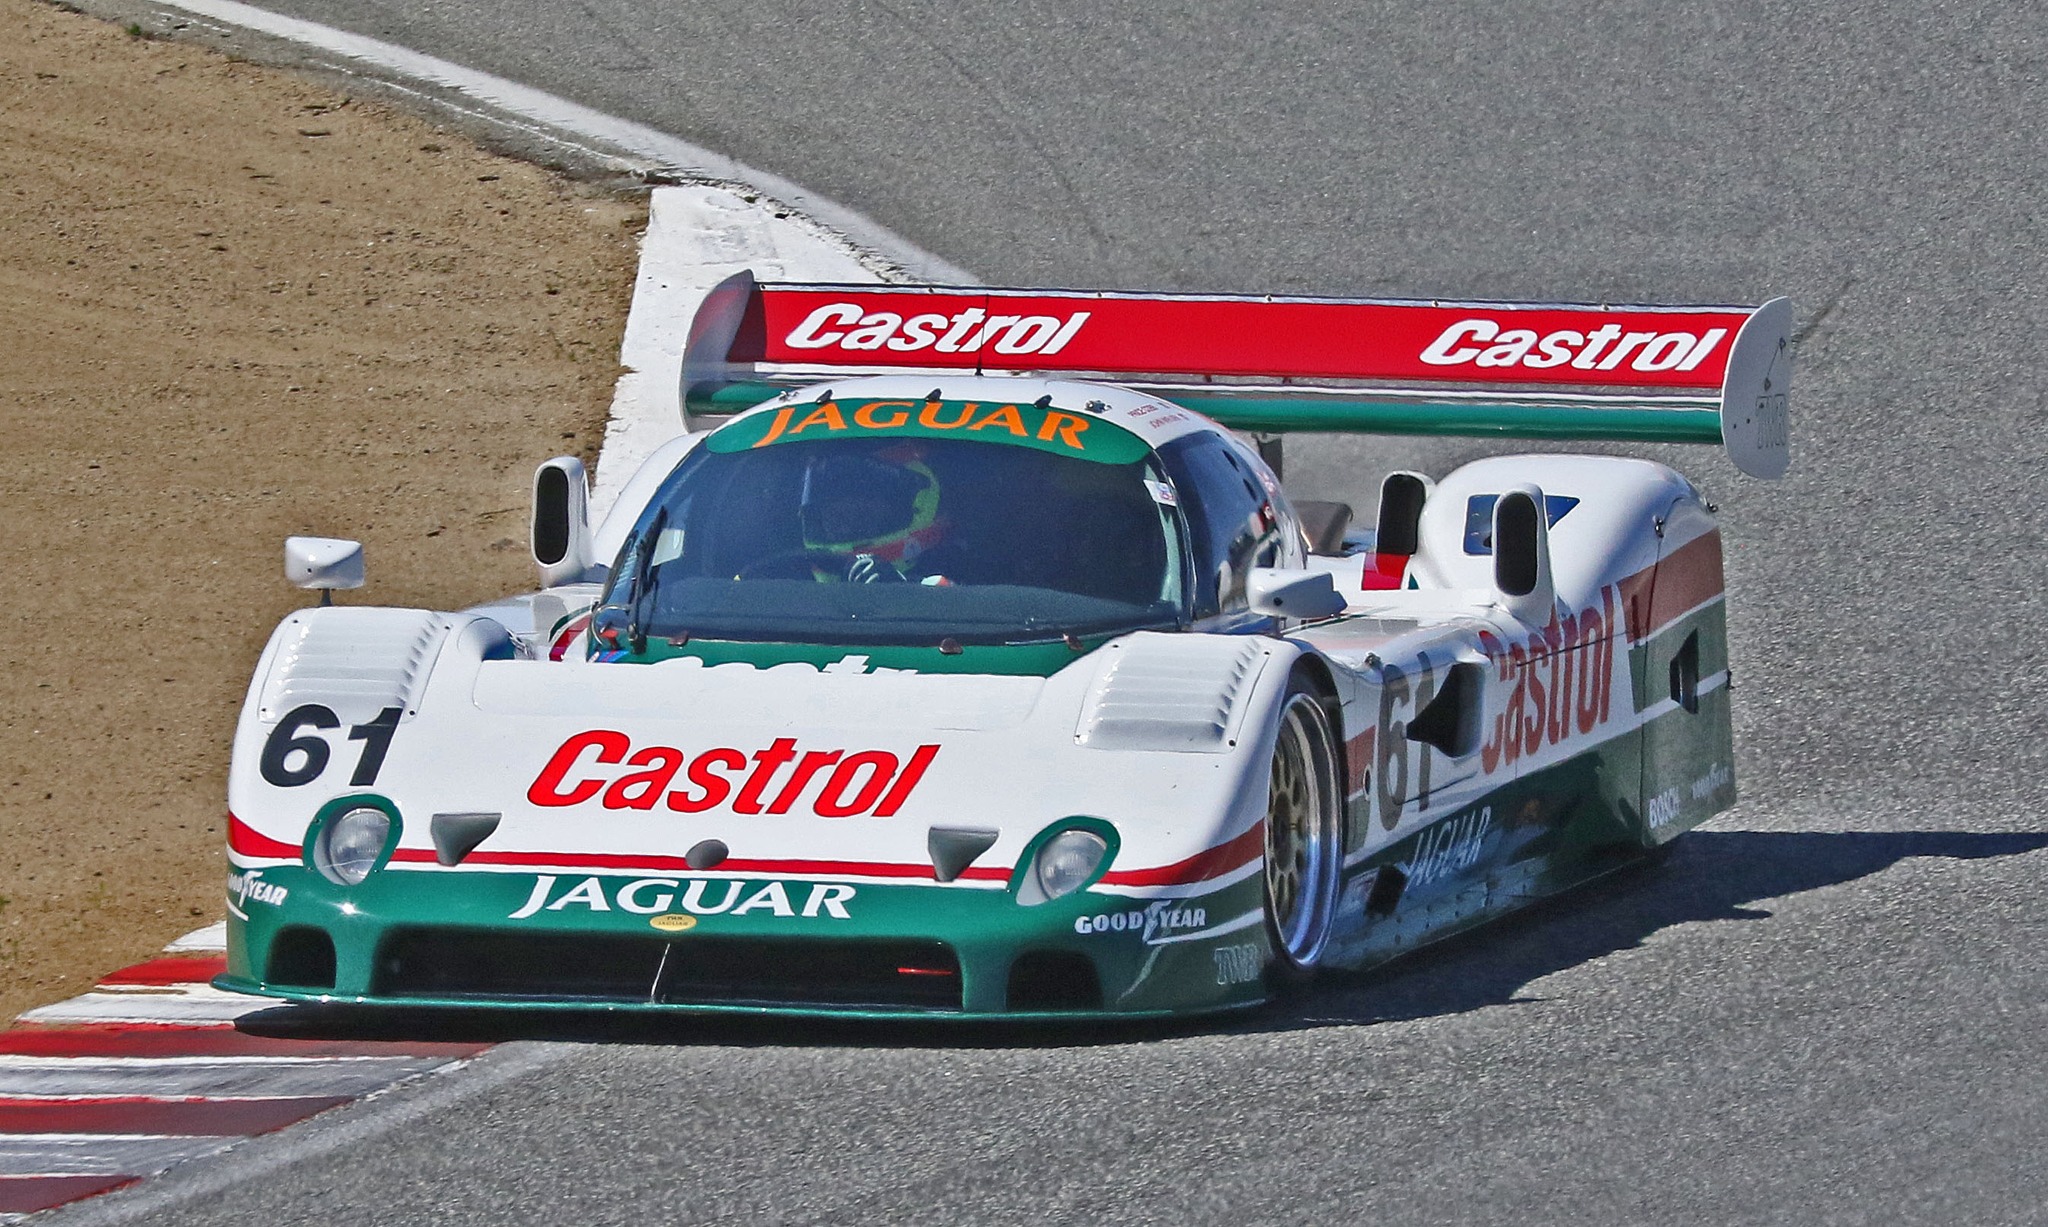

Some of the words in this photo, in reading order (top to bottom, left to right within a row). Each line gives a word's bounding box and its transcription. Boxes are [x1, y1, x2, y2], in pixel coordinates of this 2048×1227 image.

[785, 302, 1091, 355] Castrol
[1419, 319, 1728, 372] Castrol
[752, 401, 1090, 450] JAGUAR
[260, 704, 404, 788] 61
[1377, 651, 1434, 831] 61
[527, 730, 941, 818] Castrol
[508, 876, 857, 919] JAGUAR
